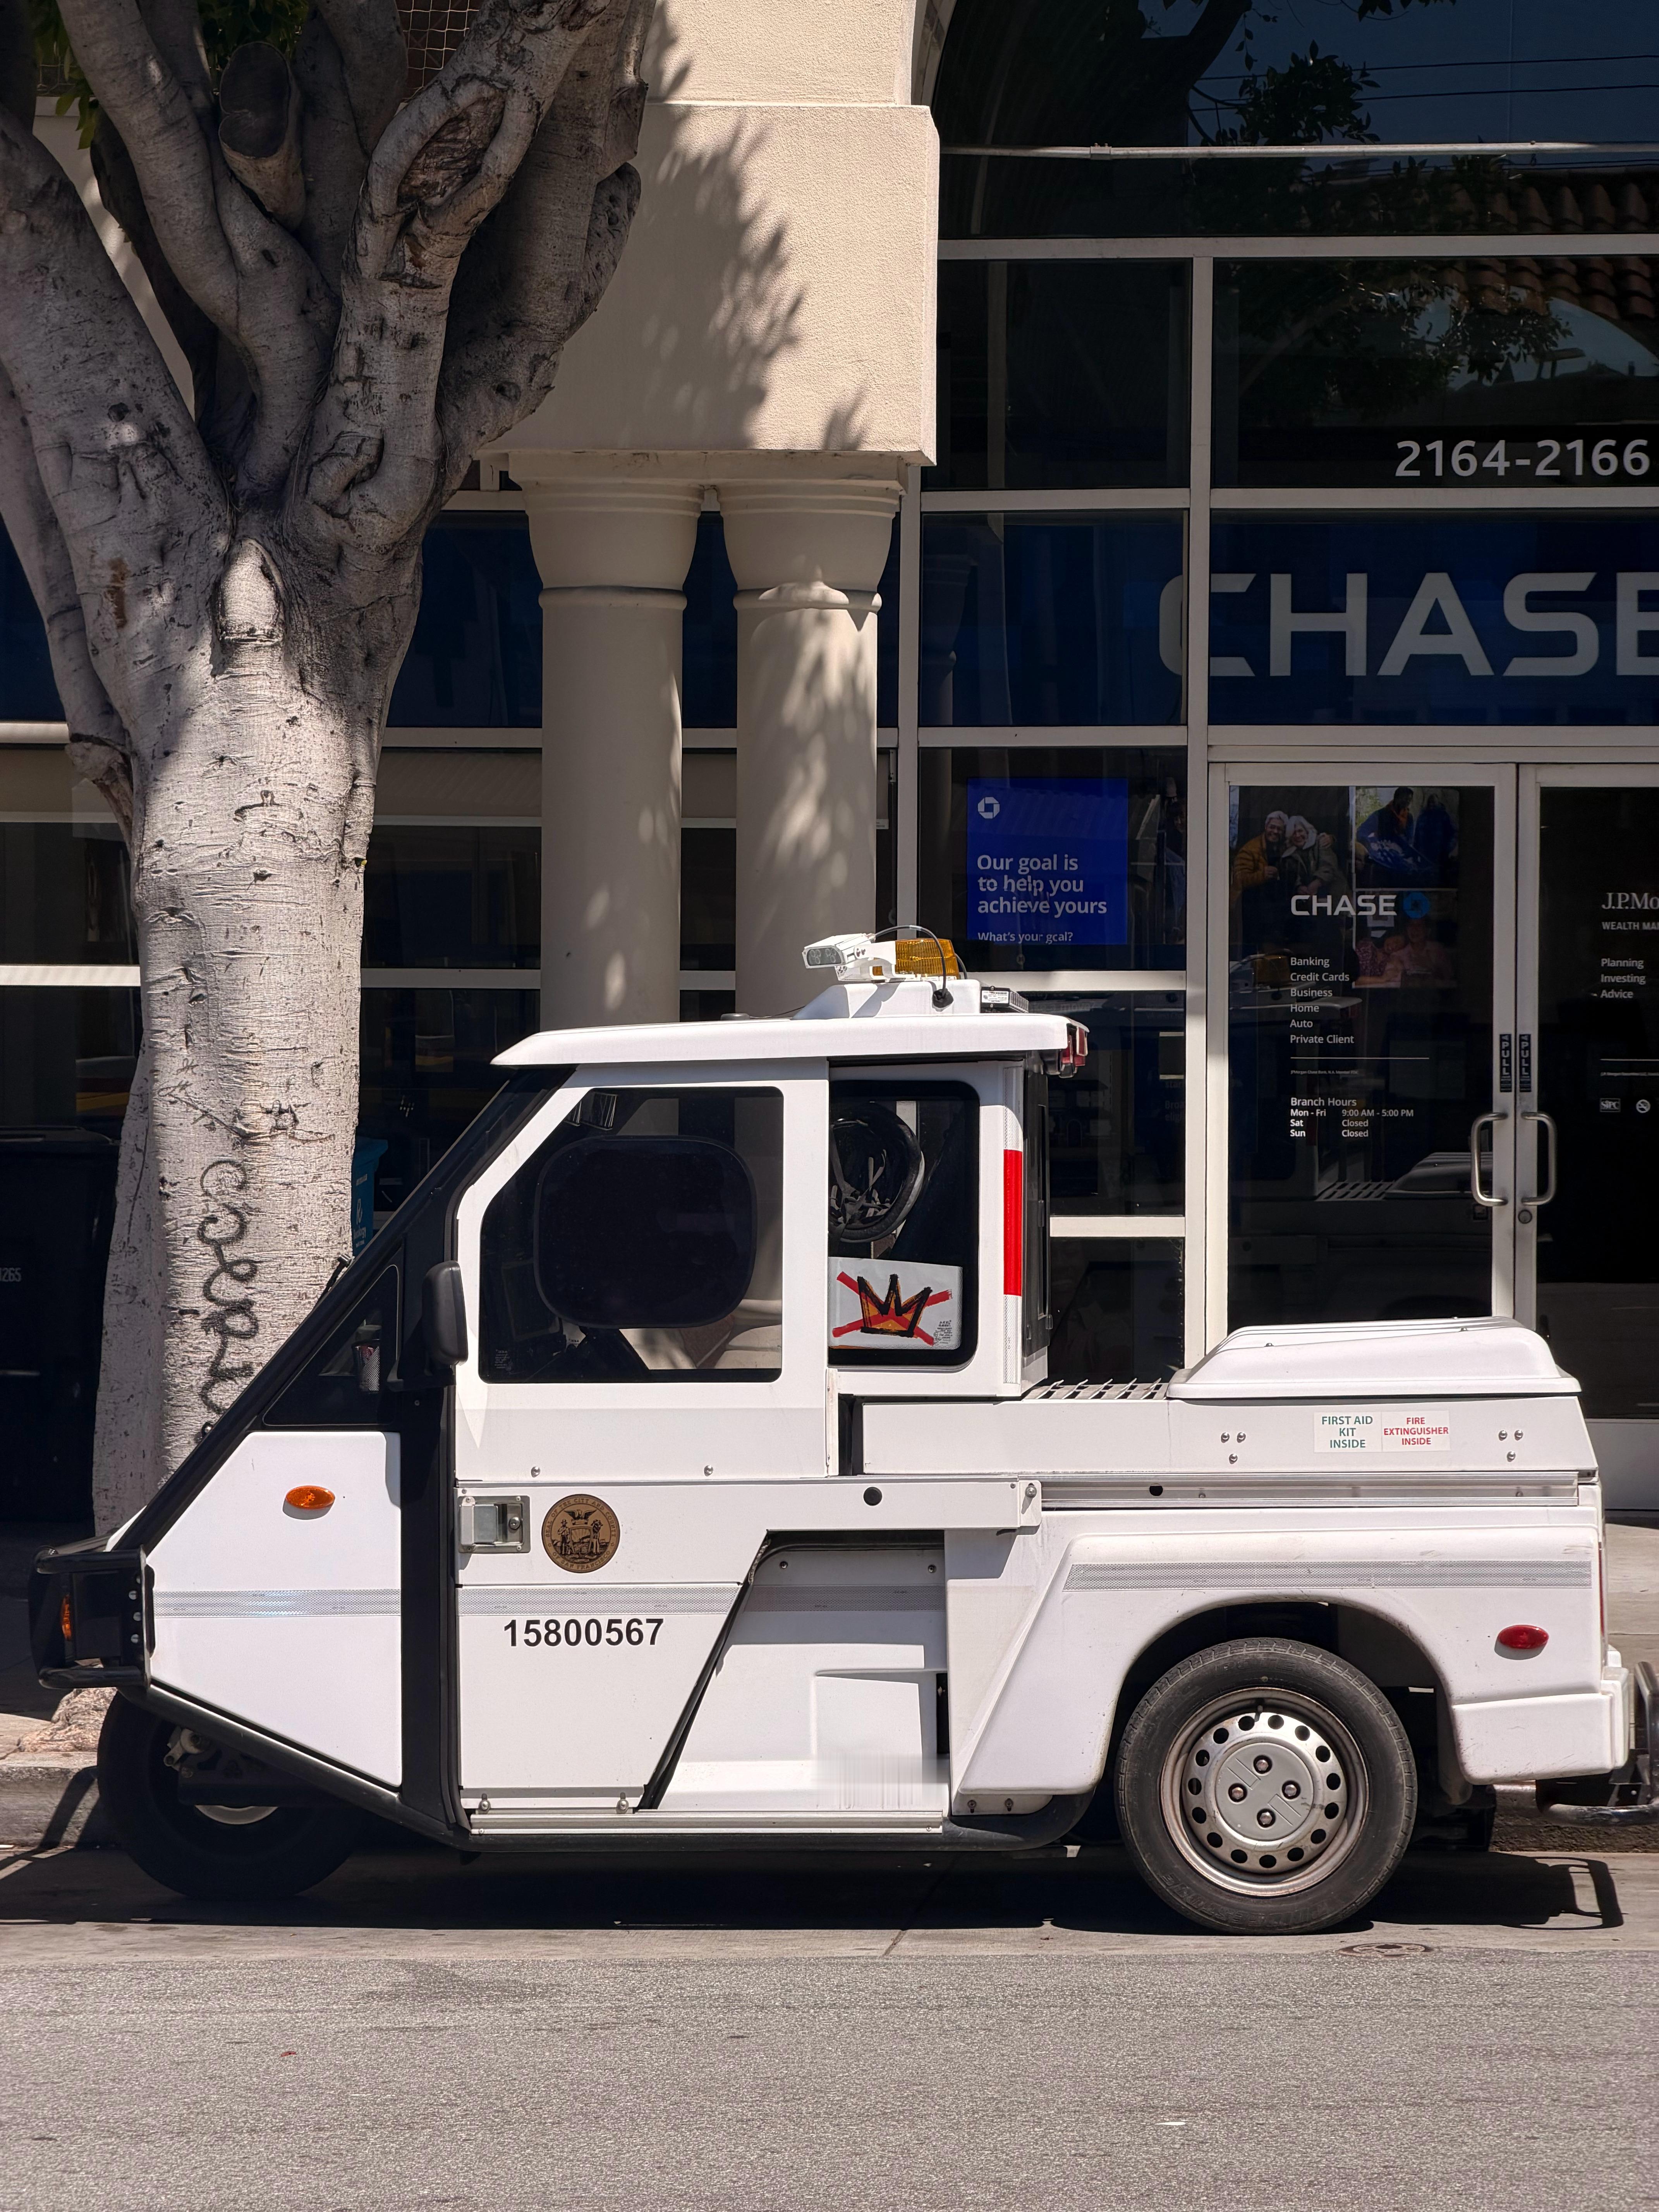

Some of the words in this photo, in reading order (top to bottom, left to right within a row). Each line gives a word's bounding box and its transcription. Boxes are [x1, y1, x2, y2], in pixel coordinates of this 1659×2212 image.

[1396, 440, 1650, 477] 2164-2166
[977, 855, 1013, 871] Our
[1018, 854, 1057, 874] goal
[1064, 854, 1078, 871] is
[978, 877, 998, 891] to
[1004, 875, 1044, 896] help
[1049, 879, 1084, 897] you
[978, 896, 1050, 914] achieve
[1054, 900, 1107, 918] yours
[1291, 895, 1397, 915] CHASE
[1602, 921, 1640, 930] WEALTH
[978, 932, 1015, 942] What's
[1018, 934, 1043, 944] your
[1290, 957, 1330, 968] Banking
[1601, 958, 1644, 969] Planning
[1290, 972, 1319, 982] Credit
[1322, 972, 1350, 982] Cards
[1601, 974, 1647, 985] Investing
[1290, 988, 1333, 997] Business
[1600, 989, 1634, 998] Advice
[1290, 1003, 1319, 1013] Home
[1290, 1019, 1313, 1028] Auto
[1290, 1034, 1324, 1044] Private
[1326, 1034, 1354, 1044] Client
[1501, 1041, 1510, 1075] PULL
[1520, 1041, 1529, 1075] PULL
[1291, 1097, 1324, 1106] Branch
[1328, 1097, 1357, 1106] Hours
[1290, 1109, 1309, 1117] Mon
[1316, 1109, 1326, 1117] Fri
[1290, 1119, 1304, 1127] Sat
[1290, 1129, 1306, 1137] Sun
[1321, 1416, 1352, 1425] FIRST
[1354, 1415, 1373, 1425] AID
[1339, 1427, 1357, 1437] KIT
[1384, 1427, 1449, 1436] EXTINGUISHER
[1330, 1439, 1366, 1449] INSIDE
[1401, 1437, 1431, 1446] INSIDE
[551, 1509, 559, 1517] OF
[591, 1499, 605, 1510] AND
[605, 1511, 617, 1538] COUNTY
[552, 1551, 559, 1561] OF
[560, 1559, 574, 1569] SAN
[576, 1551, 611, 1570] FRANCISCO
[504, 1618, 664, 1647] 15800567
